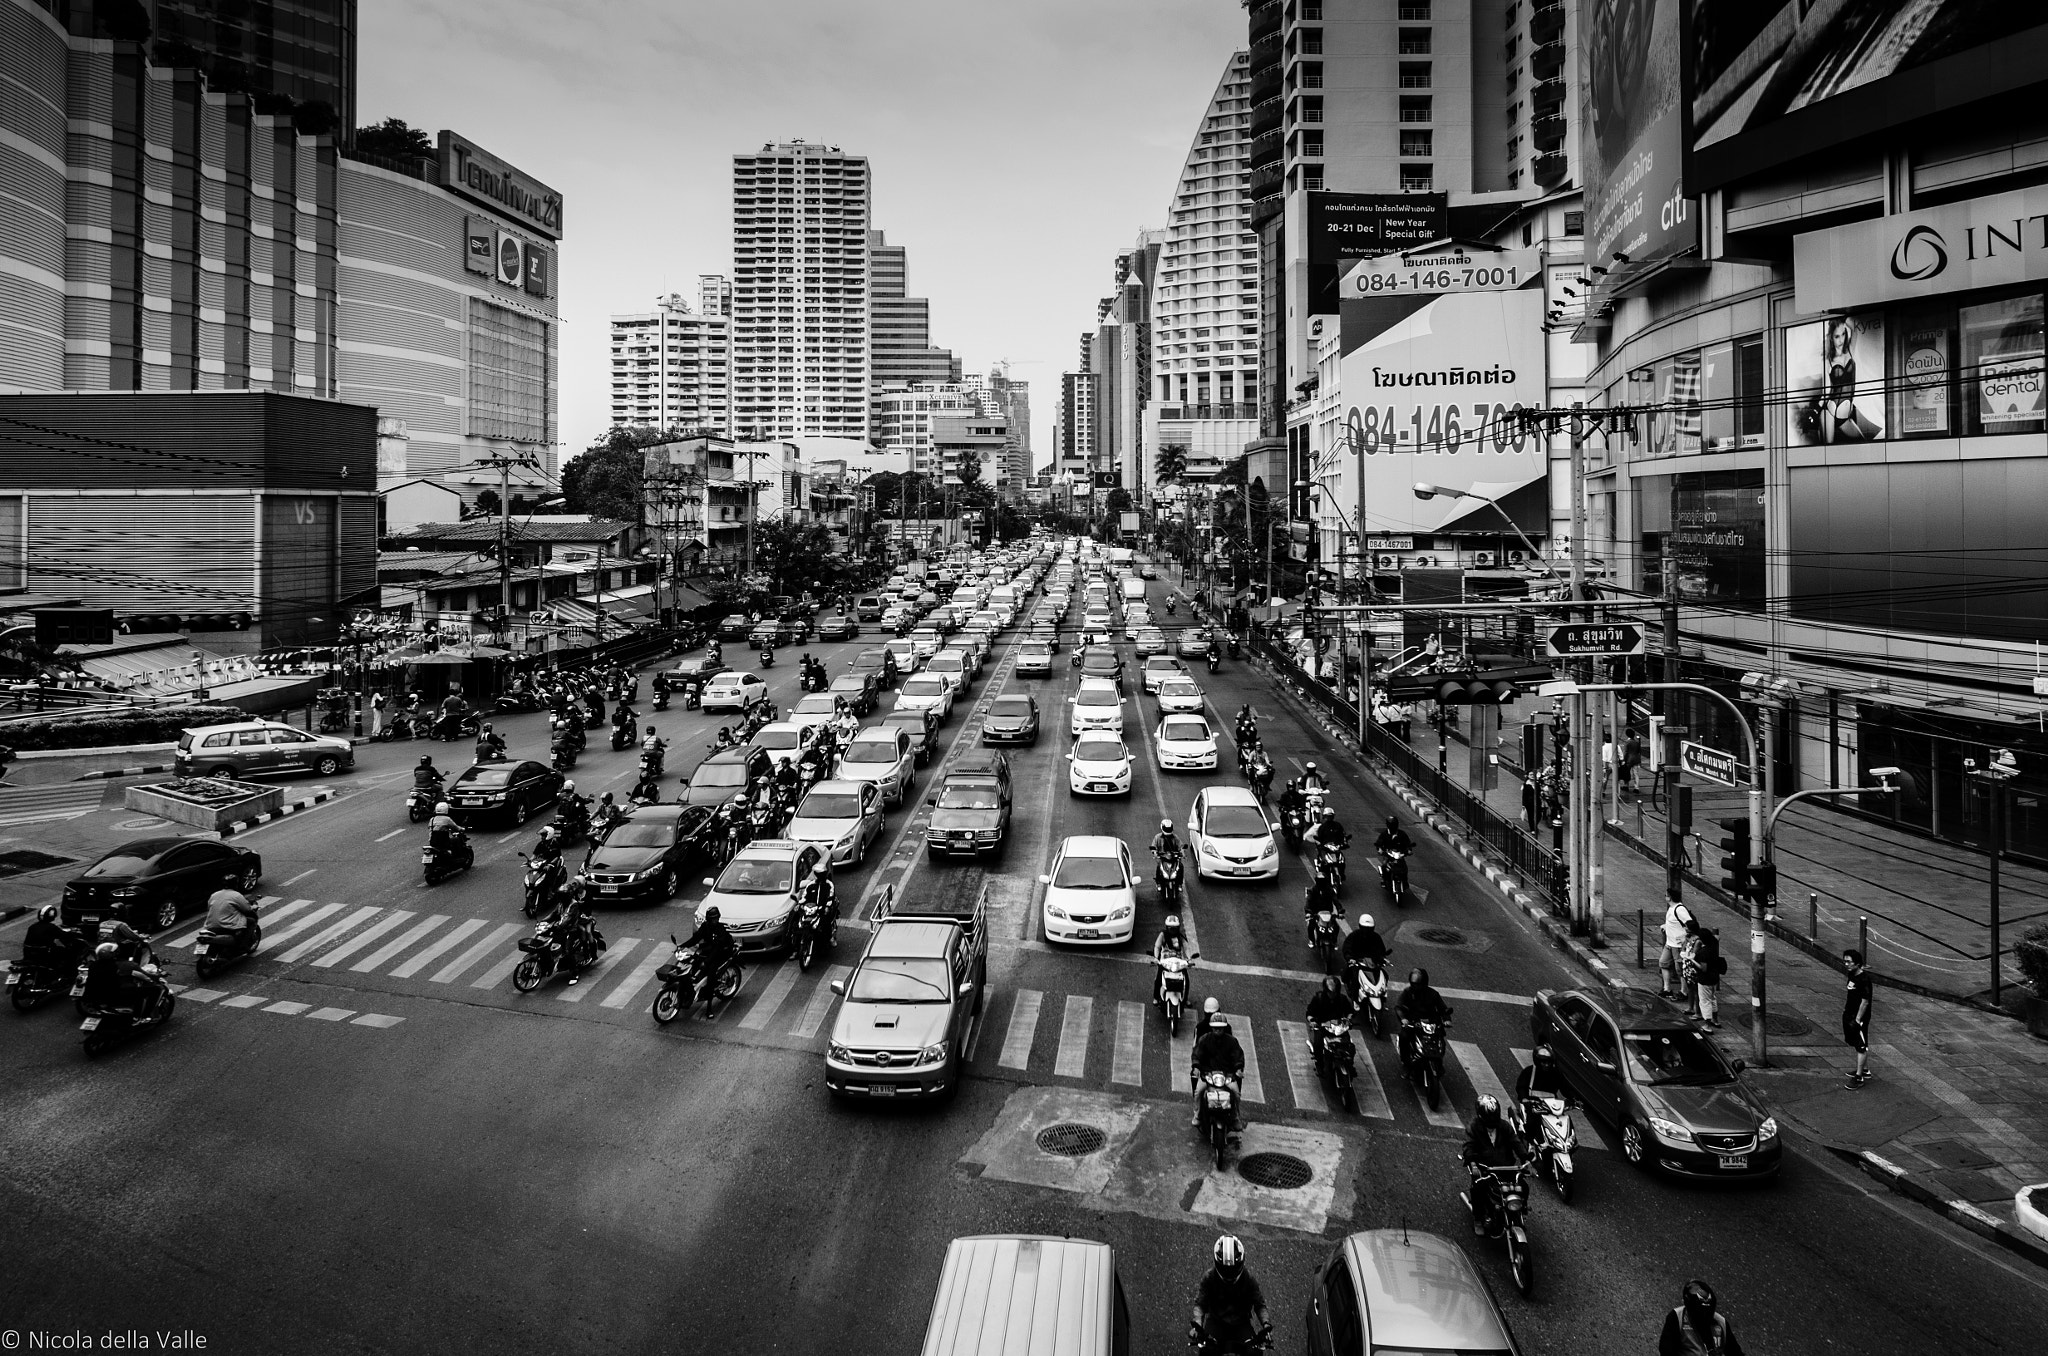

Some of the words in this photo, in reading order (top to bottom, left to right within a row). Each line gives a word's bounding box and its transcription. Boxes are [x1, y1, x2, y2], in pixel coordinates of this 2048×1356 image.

[1327, 223, 1353, 232] 20-21
[1356, 224, 1374, 233] Dec
[1385, 218, 1405, 227] New
[1407, 218, 1427, 227] Year
[1385, 229, 1416, 240] Special
[1403, 256, 1472, 268] โฆษณาติดต่อ
[1356, 266, 1518, 293] 084-146-7001
[1852, 318, 1882, 336] kyra
[1372, 364, 1516, 388] โฆษณาติดต่อ
[1985, 379, 2041, 397] dental
[1347, 401, 1542, 456] 084-146-7001
[1103, 474, 1115, 485] Q
[1567, 630, 1579, 642] ถ.
[1582, 626, 1624, 643] สุขุมวิท
[1569, 644, 1605, 652] Sukhumvit
[1610, 644, 1623, 652] Rd.
